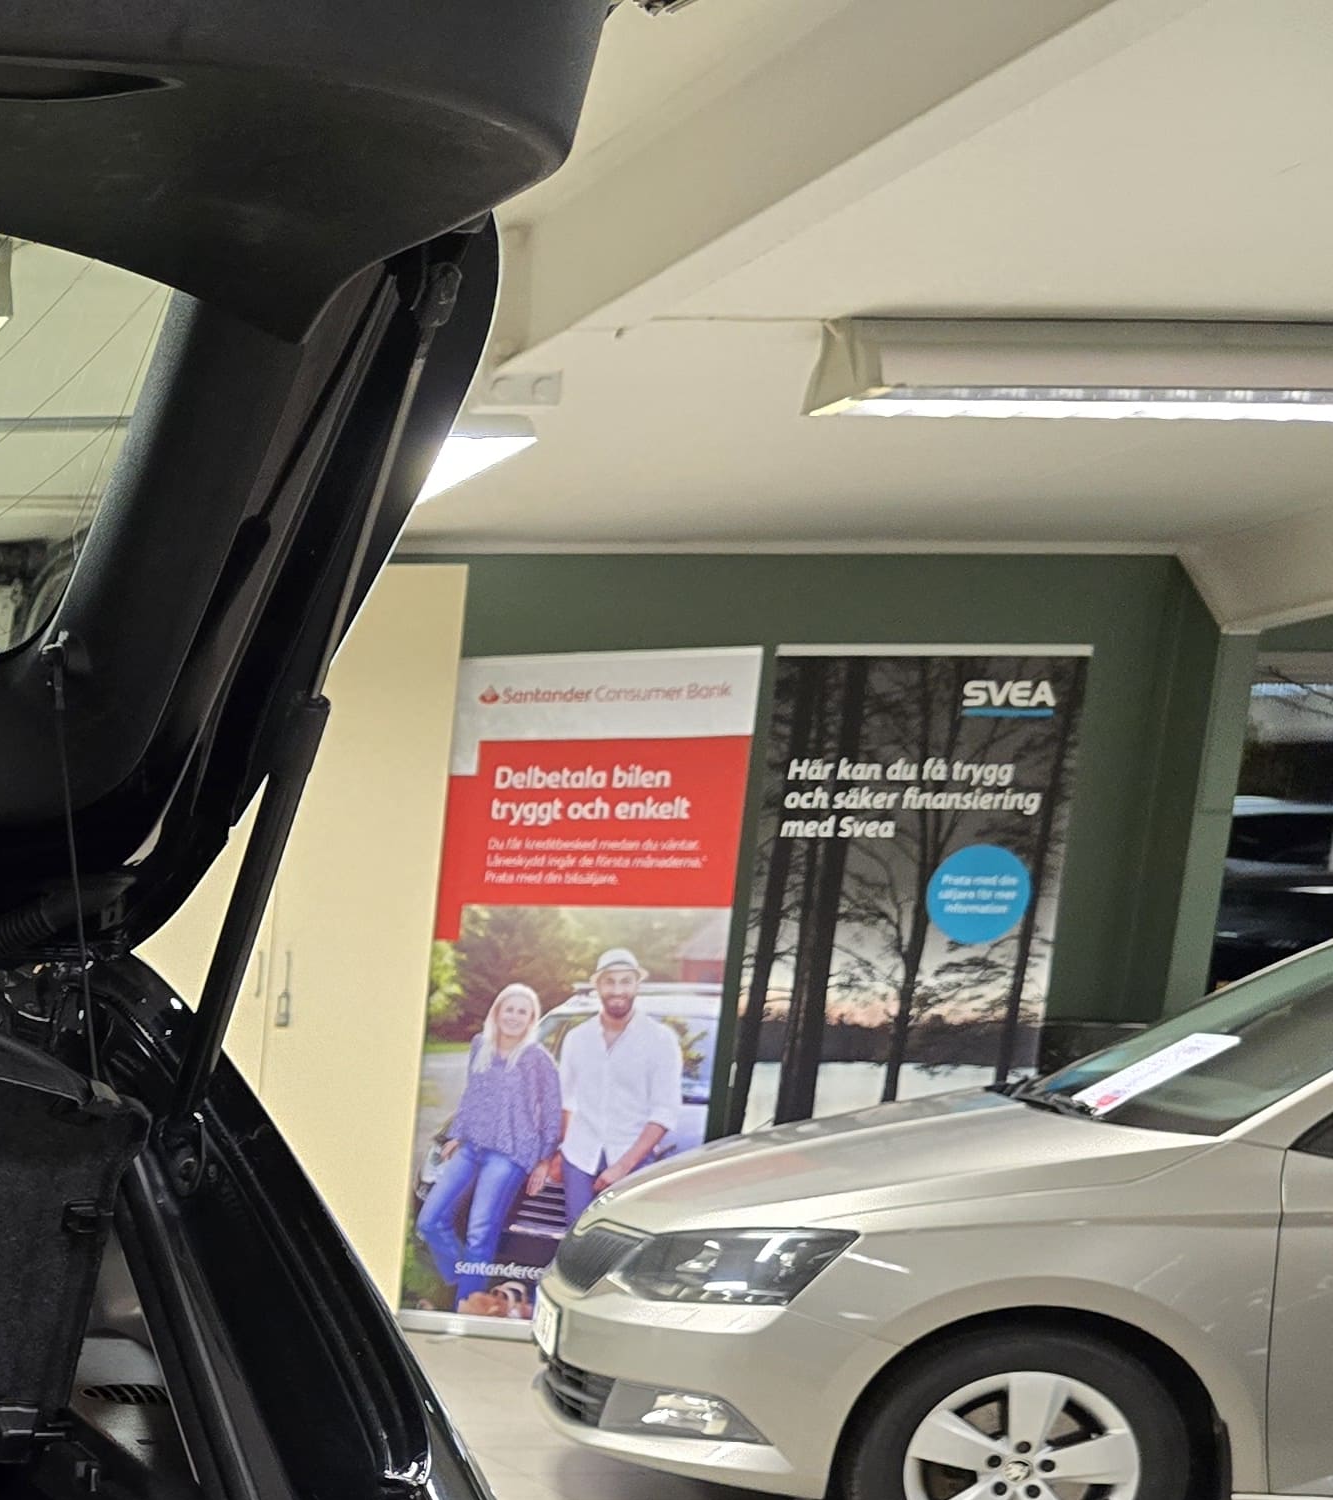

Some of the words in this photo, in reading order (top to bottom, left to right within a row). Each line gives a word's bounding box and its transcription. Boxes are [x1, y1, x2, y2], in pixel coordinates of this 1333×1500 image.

[502, 684, 592, 704] Santander
[595, 684, 682, 702] Consumer
[687, 681, 732, 700] Bank
[962, 680, 1056, 707] SVEA
[494, 764, 608, 790] Delbetala
[611, 764, 672, 789] bilen
[787, 758, 835, 781] Här
[836, 757, 882, 781] kan
[886, 757, 918, 781] du
[921, 757, 948, 781] få
[951, 760, 1016, 787] trygg
[491, 797, 564, 827] tryggt
[567, 796, 610, 820] och
[614, 796, 691, 820] enkelt
[783, 786, 830, 810] och
[832, 786, 900, 810] säker
[901, 786, 1044, 815] finansiering
[780, 814, 835, 838] med
[837, 815, 896, 838] Svea
